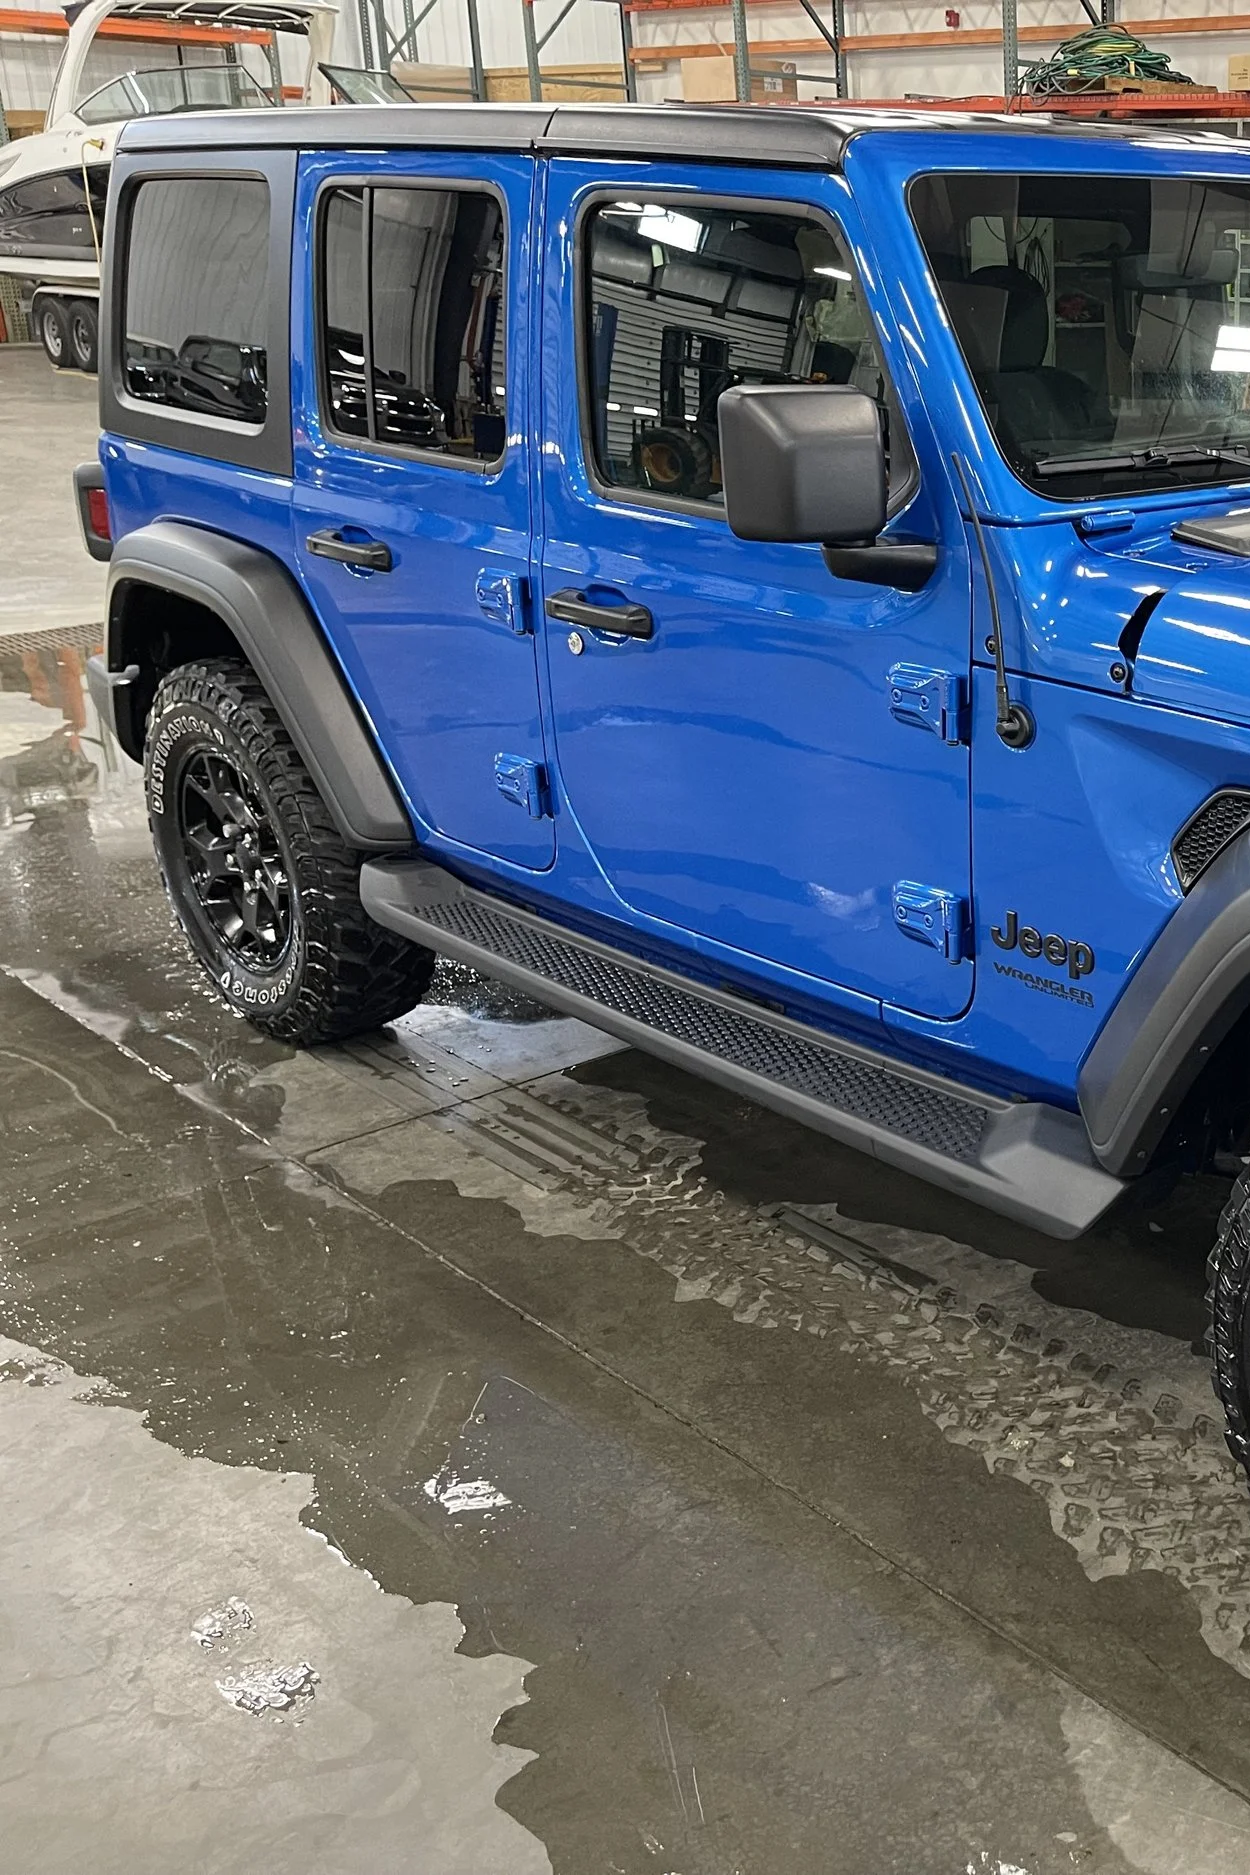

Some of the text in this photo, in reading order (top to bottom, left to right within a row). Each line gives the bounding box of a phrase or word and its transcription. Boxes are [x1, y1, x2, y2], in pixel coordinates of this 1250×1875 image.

[150, 714, 214, 816] DESTINATION
[990, 909, 1095, 980] Jeep
[993, 961, 1094, 1003] WRANGLER
[1024, 981, 1095, 1009] UNLIMITED
